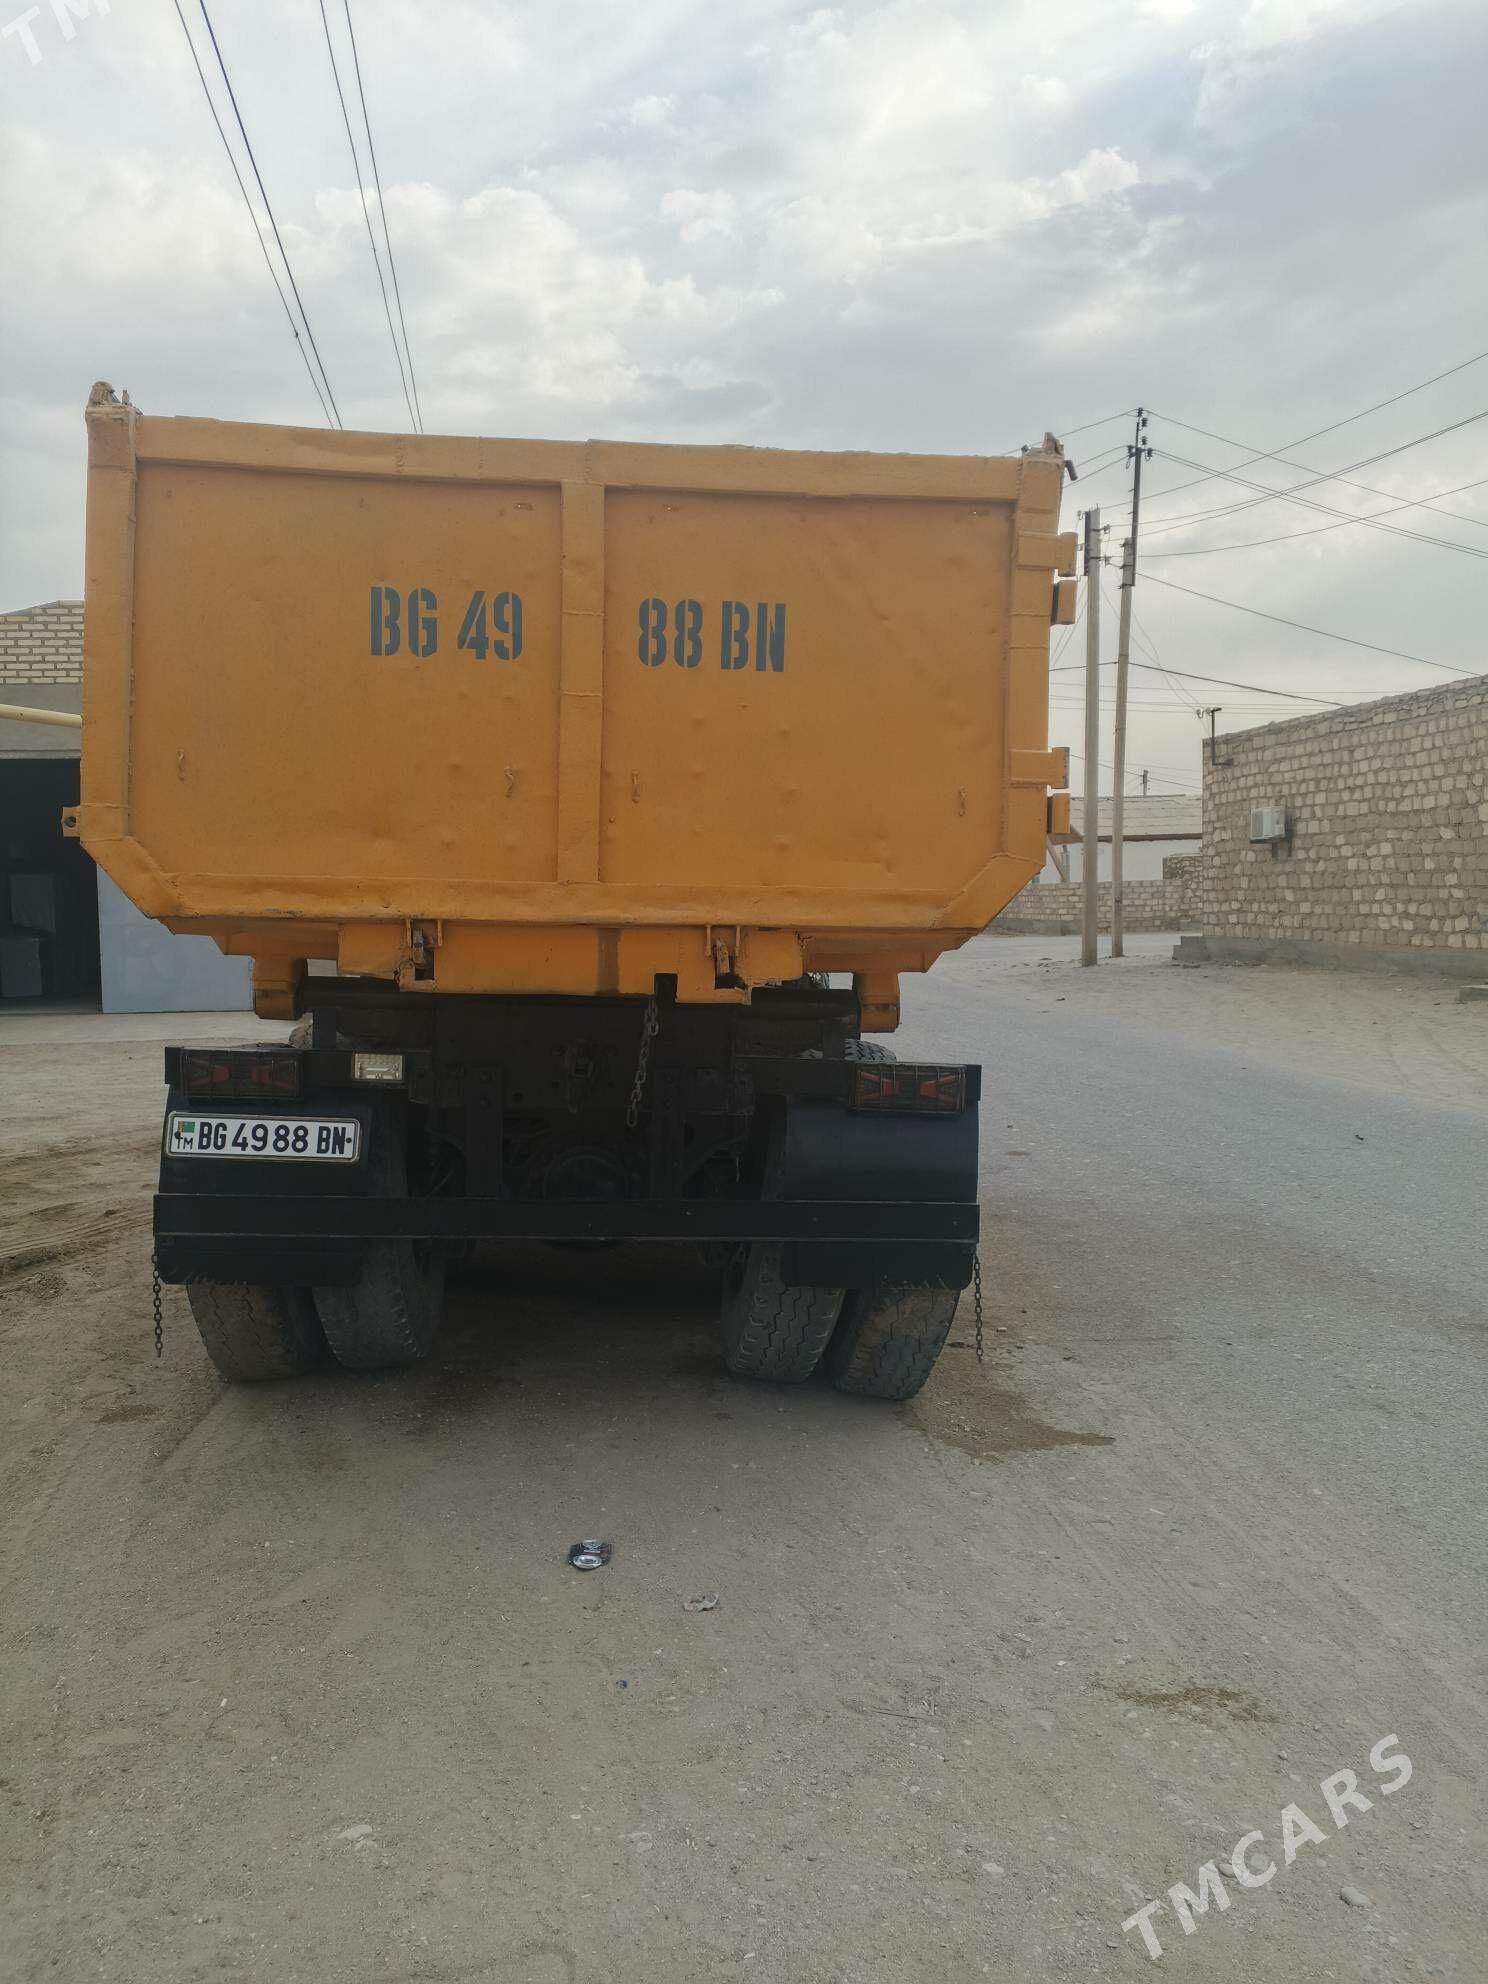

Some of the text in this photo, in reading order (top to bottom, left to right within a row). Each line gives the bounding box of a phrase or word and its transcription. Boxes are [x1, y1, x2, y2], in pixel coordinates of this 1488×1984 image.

[370, 586, 787, 673] BG 49 88 BN
